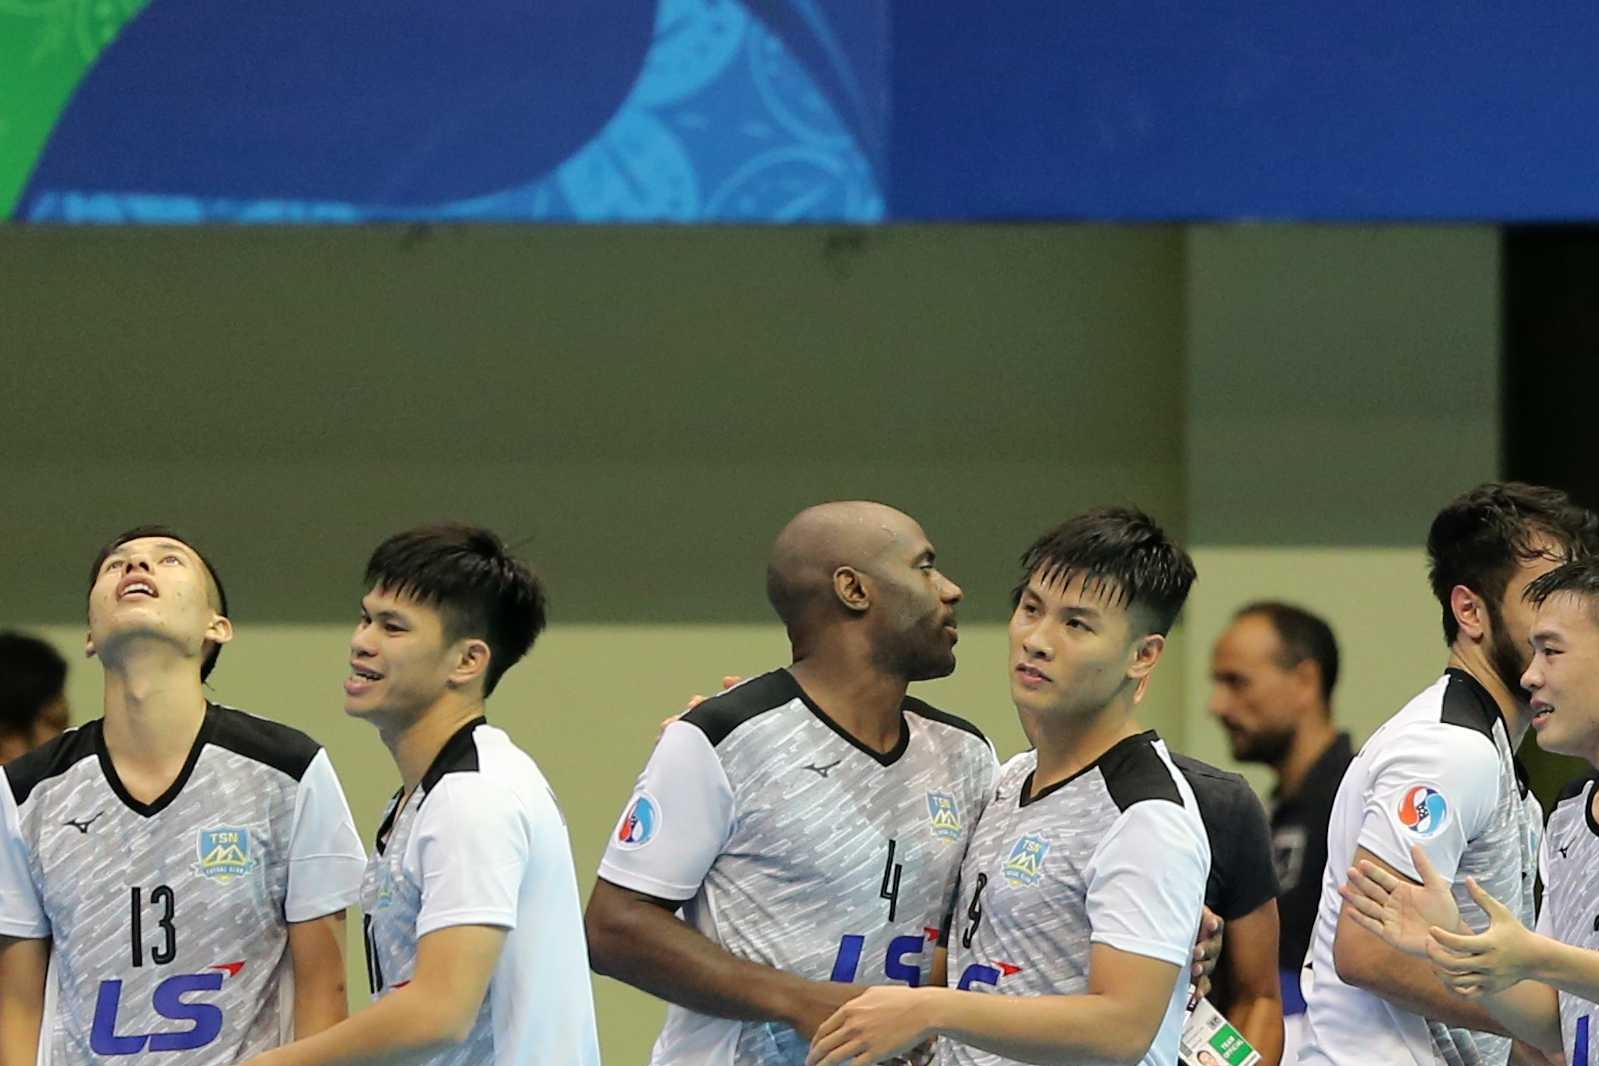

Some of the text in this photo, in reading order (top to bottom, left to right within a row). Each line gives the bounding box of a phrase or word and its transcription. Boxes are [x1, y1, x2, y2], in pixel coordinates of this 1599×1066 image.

[208, 831, 239, 844] TSN
[880, 839, 902, 922] 4
[132, 885, 177, 968] 13
[89, 972, 225, 1055] LS
